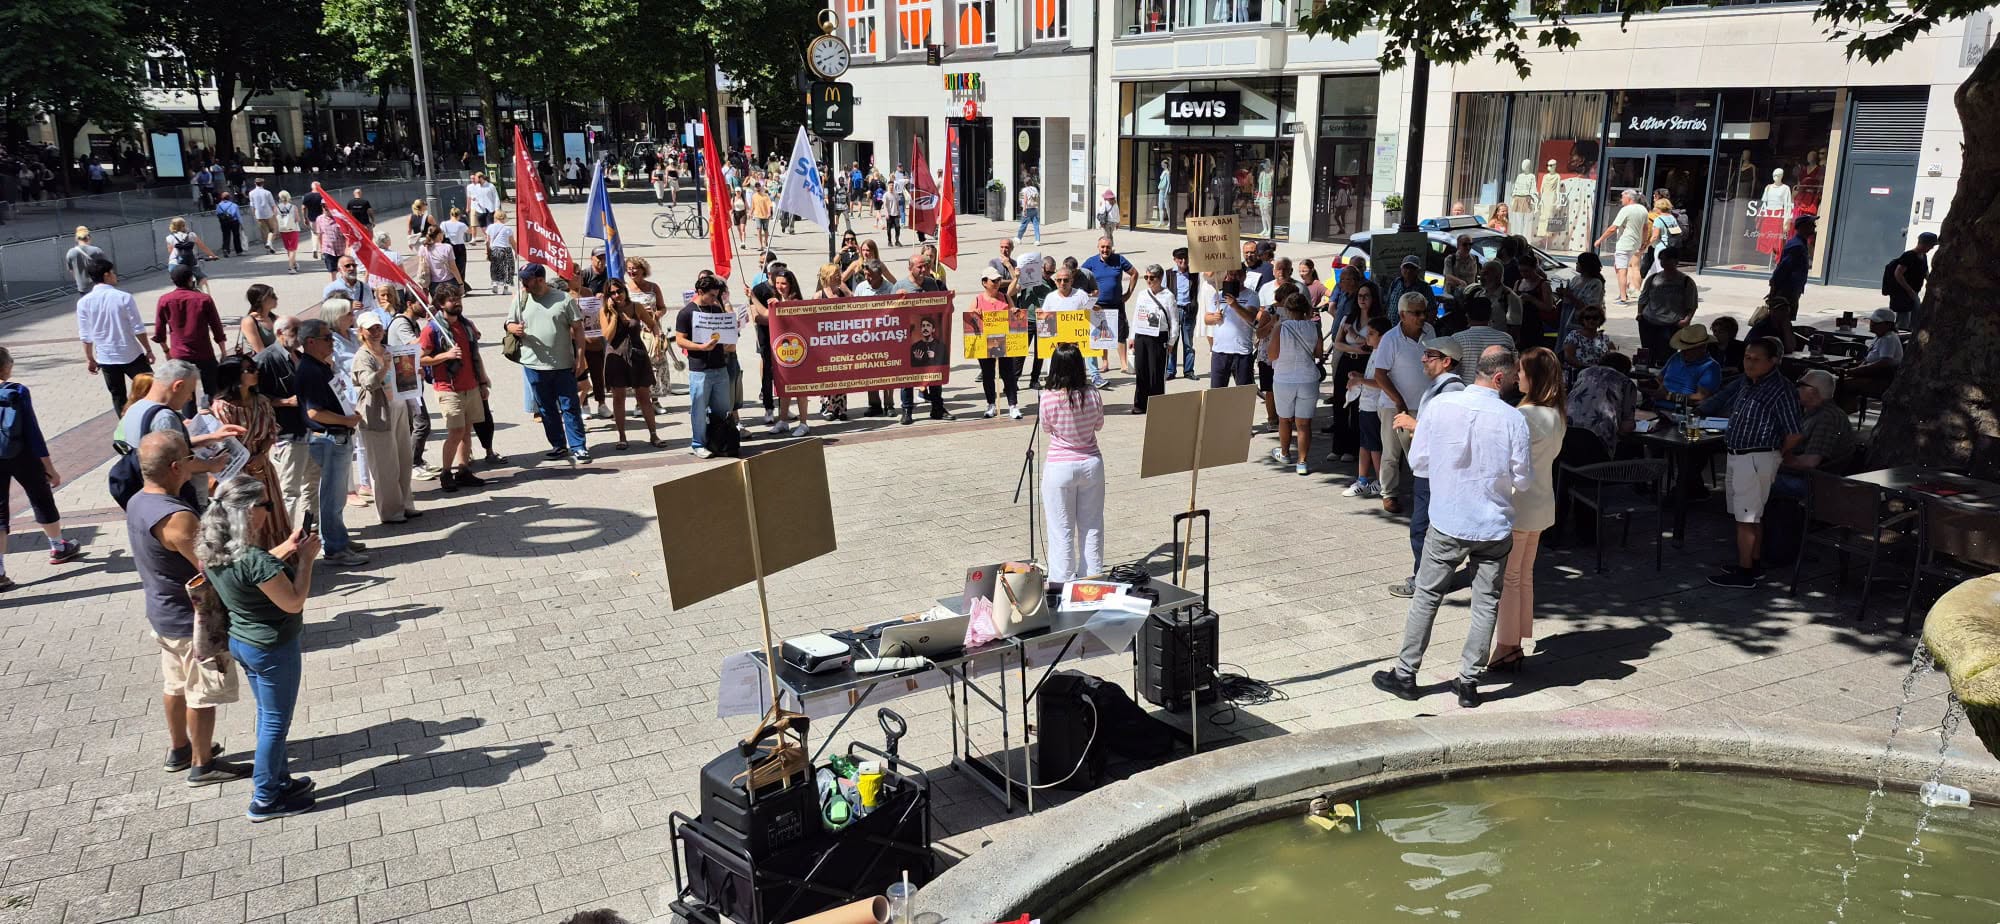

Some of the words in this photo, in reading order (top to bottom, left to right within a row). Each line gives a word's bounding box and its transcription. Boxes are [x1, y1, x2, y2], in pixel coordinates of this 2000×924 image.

[944, 72, 980, 91] BUTLERS
[1669, 115, 1707, 131] Stories
[1212, 217, 1233, 226] ADAM
[802, 306, 817, 314] weg
[833, 303, 846, 311] der
[871, 300, 886, 308] und
[817, 317, 872, 333] FREIHEIT
[875, 314, 900, 329] FÜR
[809, 332, 849, 347] DENİZ
[851, 328, 908, 345] GÖKTAŞ!
[829, 353, 854, 363] DENİZ
[855, 351, 889, 362] GÖKTAŞ
[816, 363, 853, 373] SERBEST
